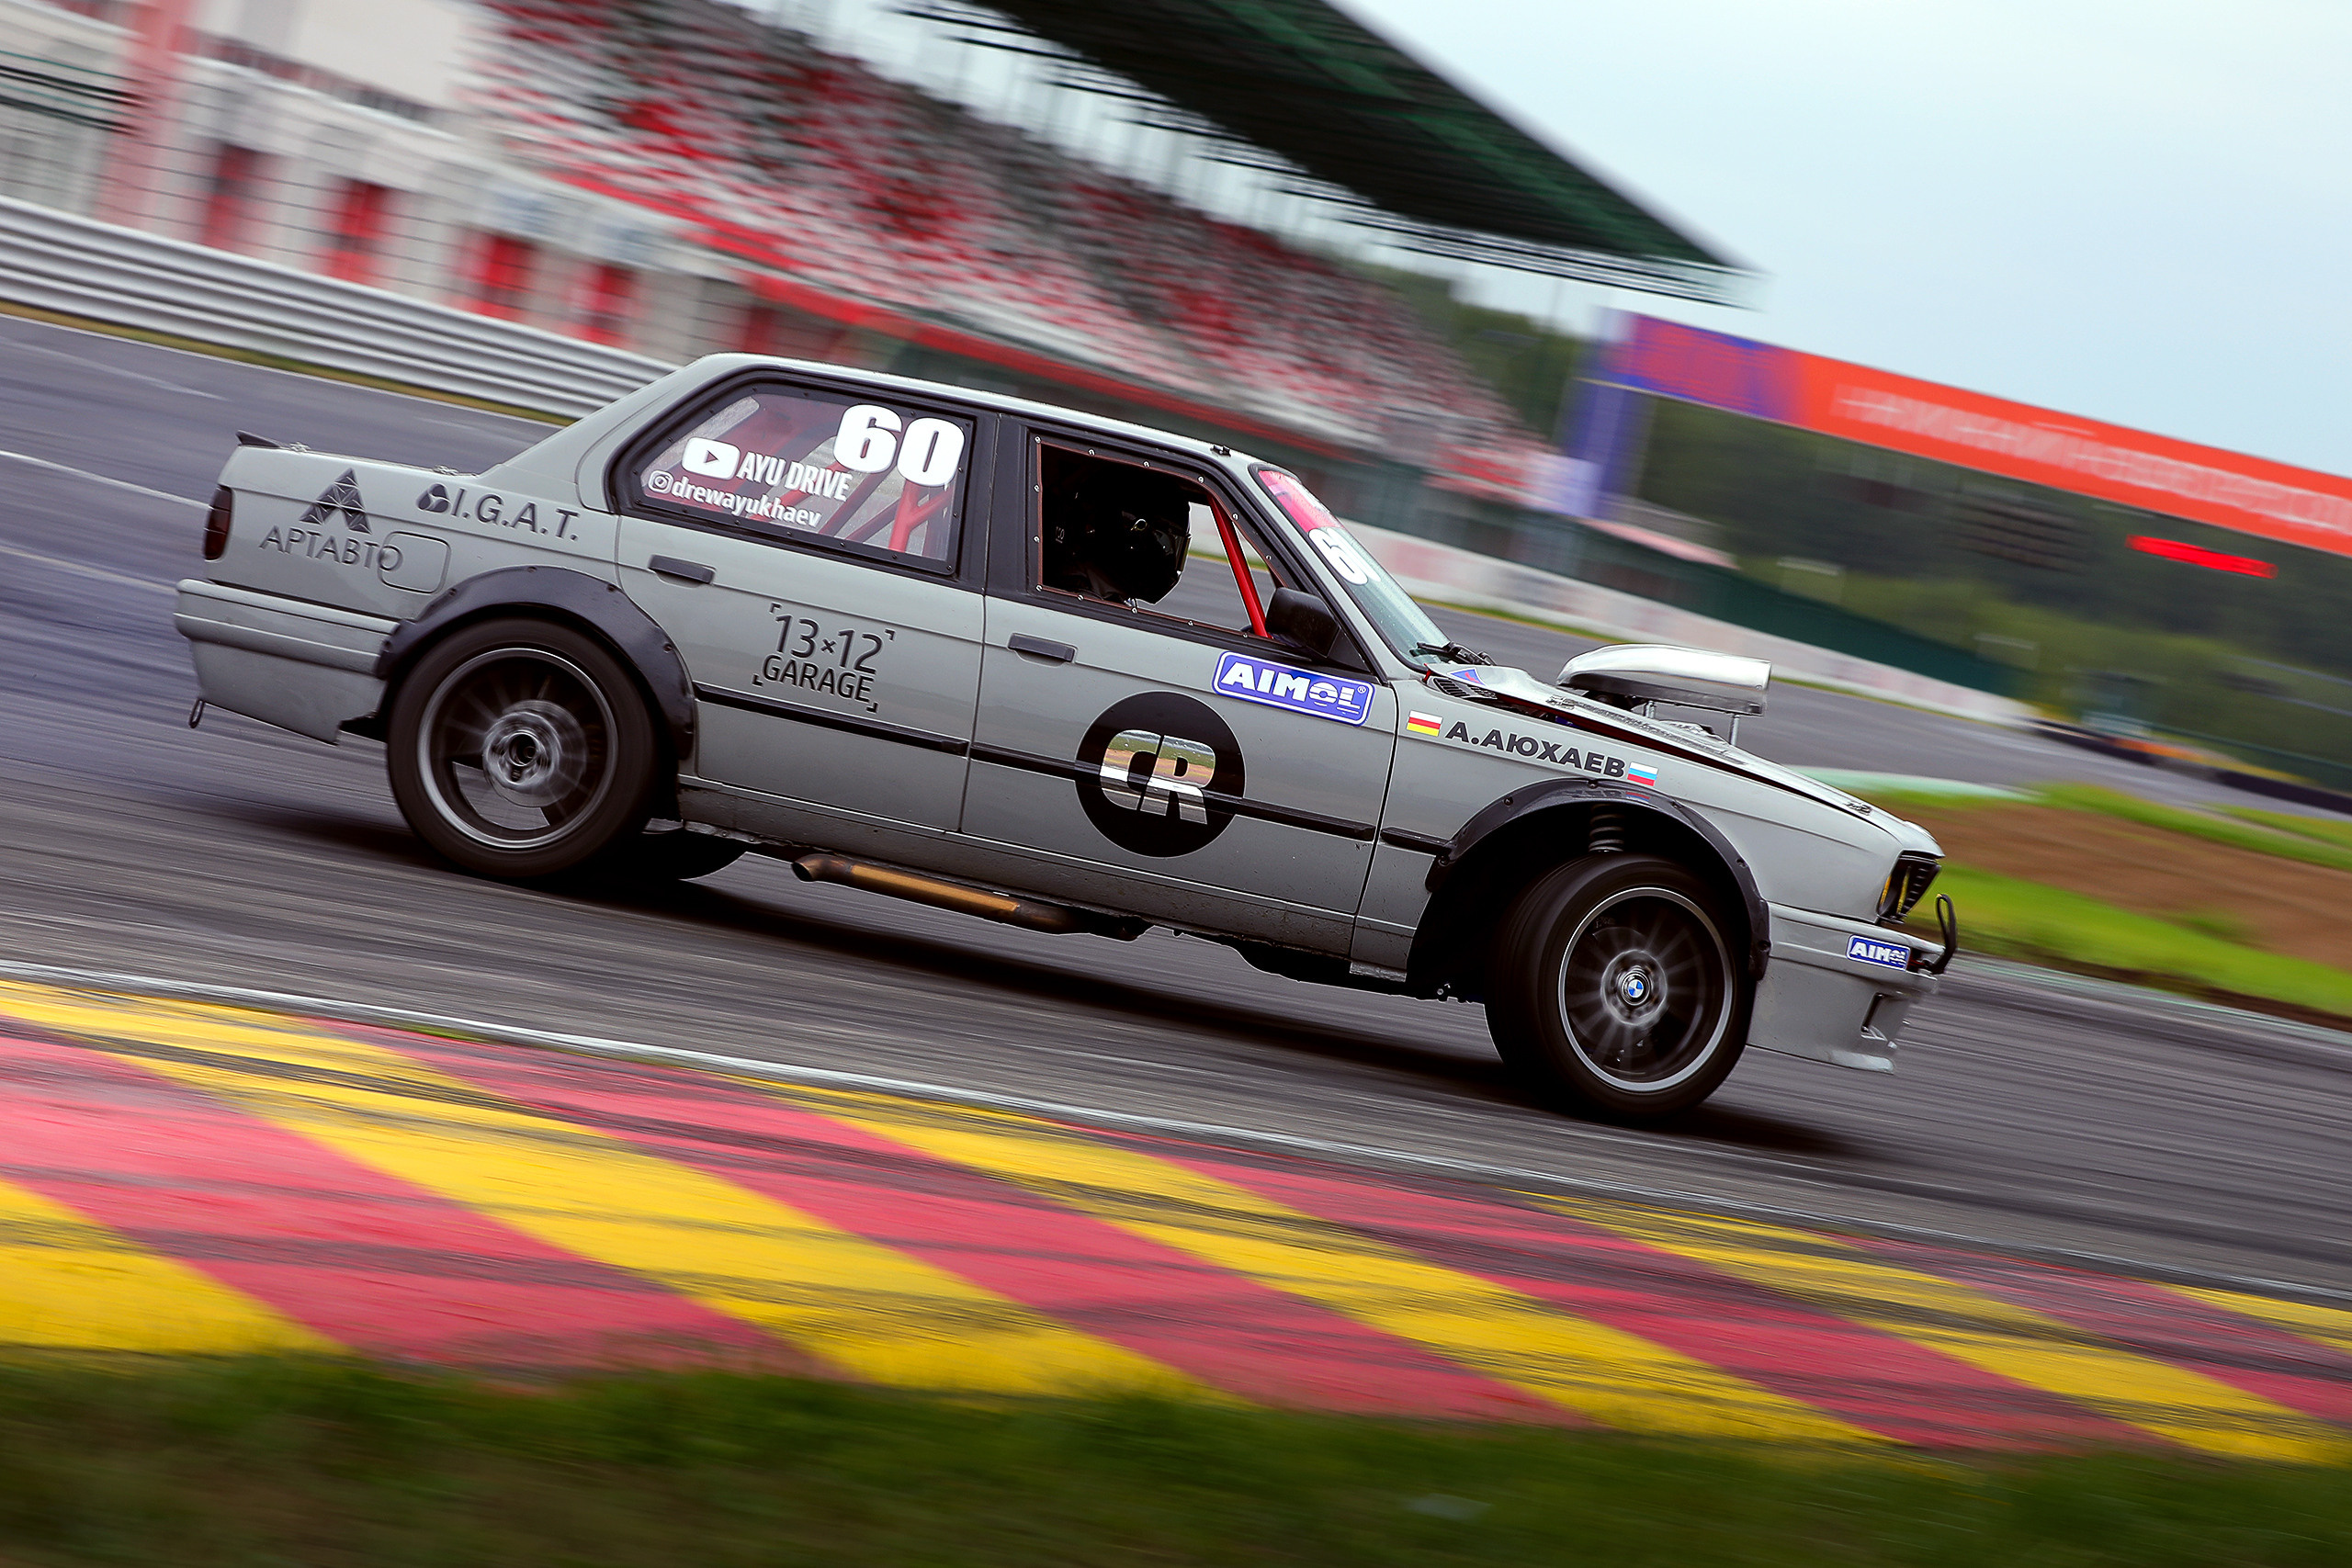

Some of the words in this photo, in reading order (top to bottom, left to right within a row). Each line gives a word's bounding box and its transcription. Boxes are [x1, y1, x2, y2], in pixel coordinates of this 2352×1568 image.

[832, 403, 966, 487] 60
[671, 475, 822, 528] drewayukhaev
[736, 451, 786, 487] AYU
[784, 460, 854, 502] DRIVE
[450, 488, 581, 542] I.G.A.T.
[259, 525, 403, 572] АРТАВТО
[762, 654, 875, 703] GARAGE
[1444, 720, 1626, 778] А.АЮХАЕВ
